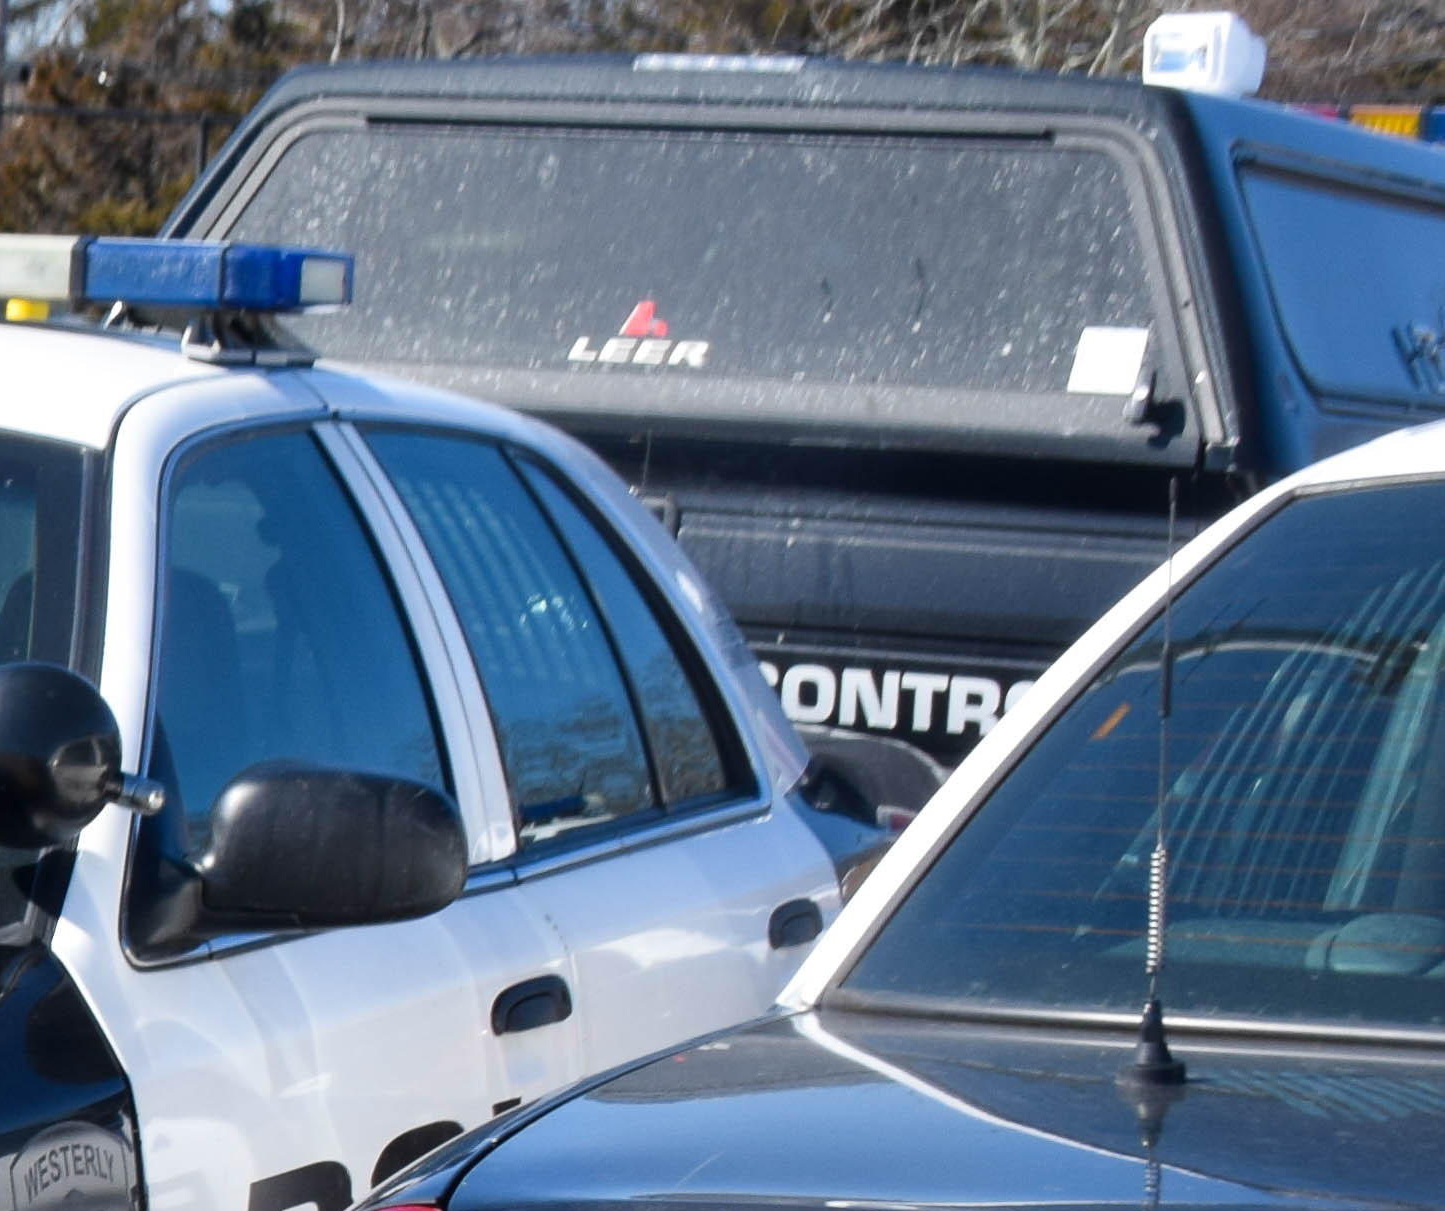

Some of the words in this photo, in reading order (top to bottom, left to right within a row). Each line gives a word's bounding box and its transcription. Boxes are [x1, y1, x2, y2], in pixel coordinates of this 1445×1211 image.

[567, 335, 710, 368] LEER
[758, 661, 1039, 737] ONTR
[23, 1143, 115, 1203] WESTERLY
